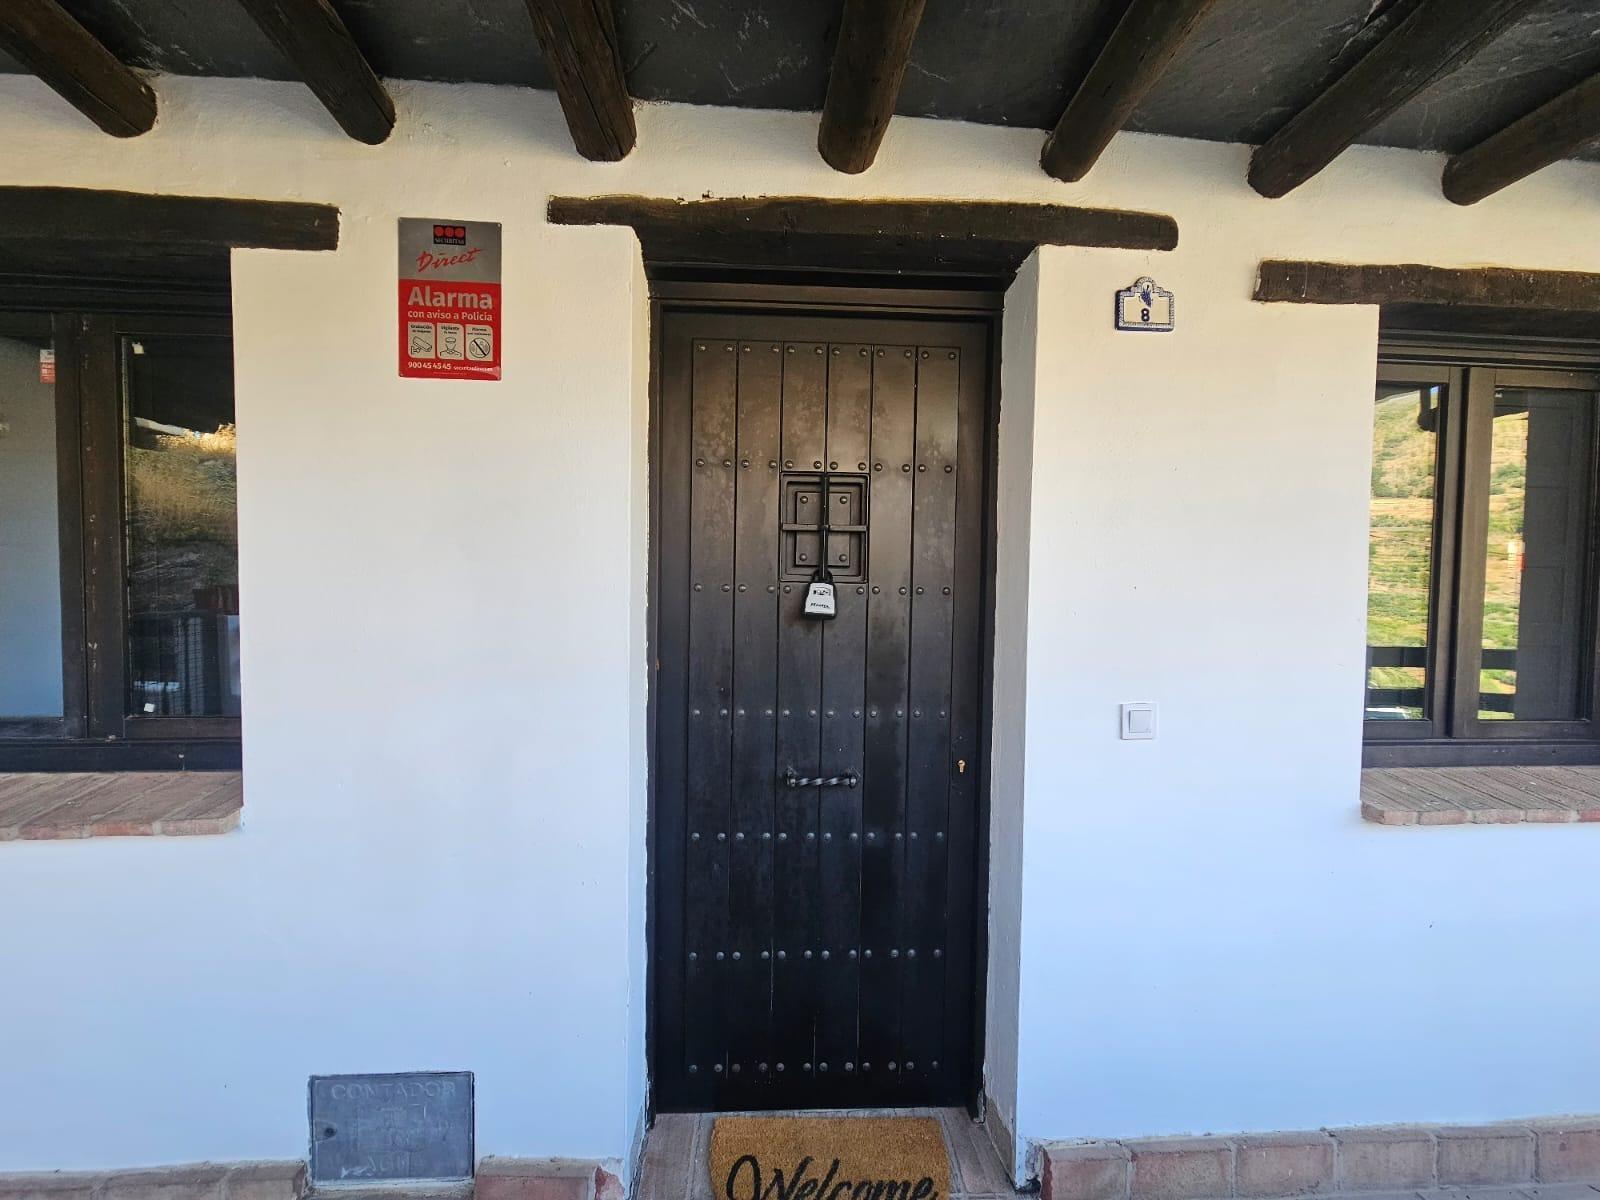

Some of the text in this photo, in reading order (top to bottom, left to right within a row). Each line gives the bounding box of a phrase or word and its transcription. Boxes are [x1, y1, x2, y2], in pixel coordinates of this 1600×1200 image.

[416, 248, 482, 272] Direct
[408, 286, 493, 310] Alarma
[407, 310, 424, 318] con
[426, 309, 451, 320] aviso
[453, 312, 460, 320] a
[1141, 308, 1151, 322] 8
[407, 361, 422, 369] 900
[422, 362, 432, 370] 45
[432, 362, 442, 370] 45
[442, 363, 452, 371] 45
[331, 1080, 456, 1100] CONTADOR
[726, 1154, 938, 1200] Welcome
